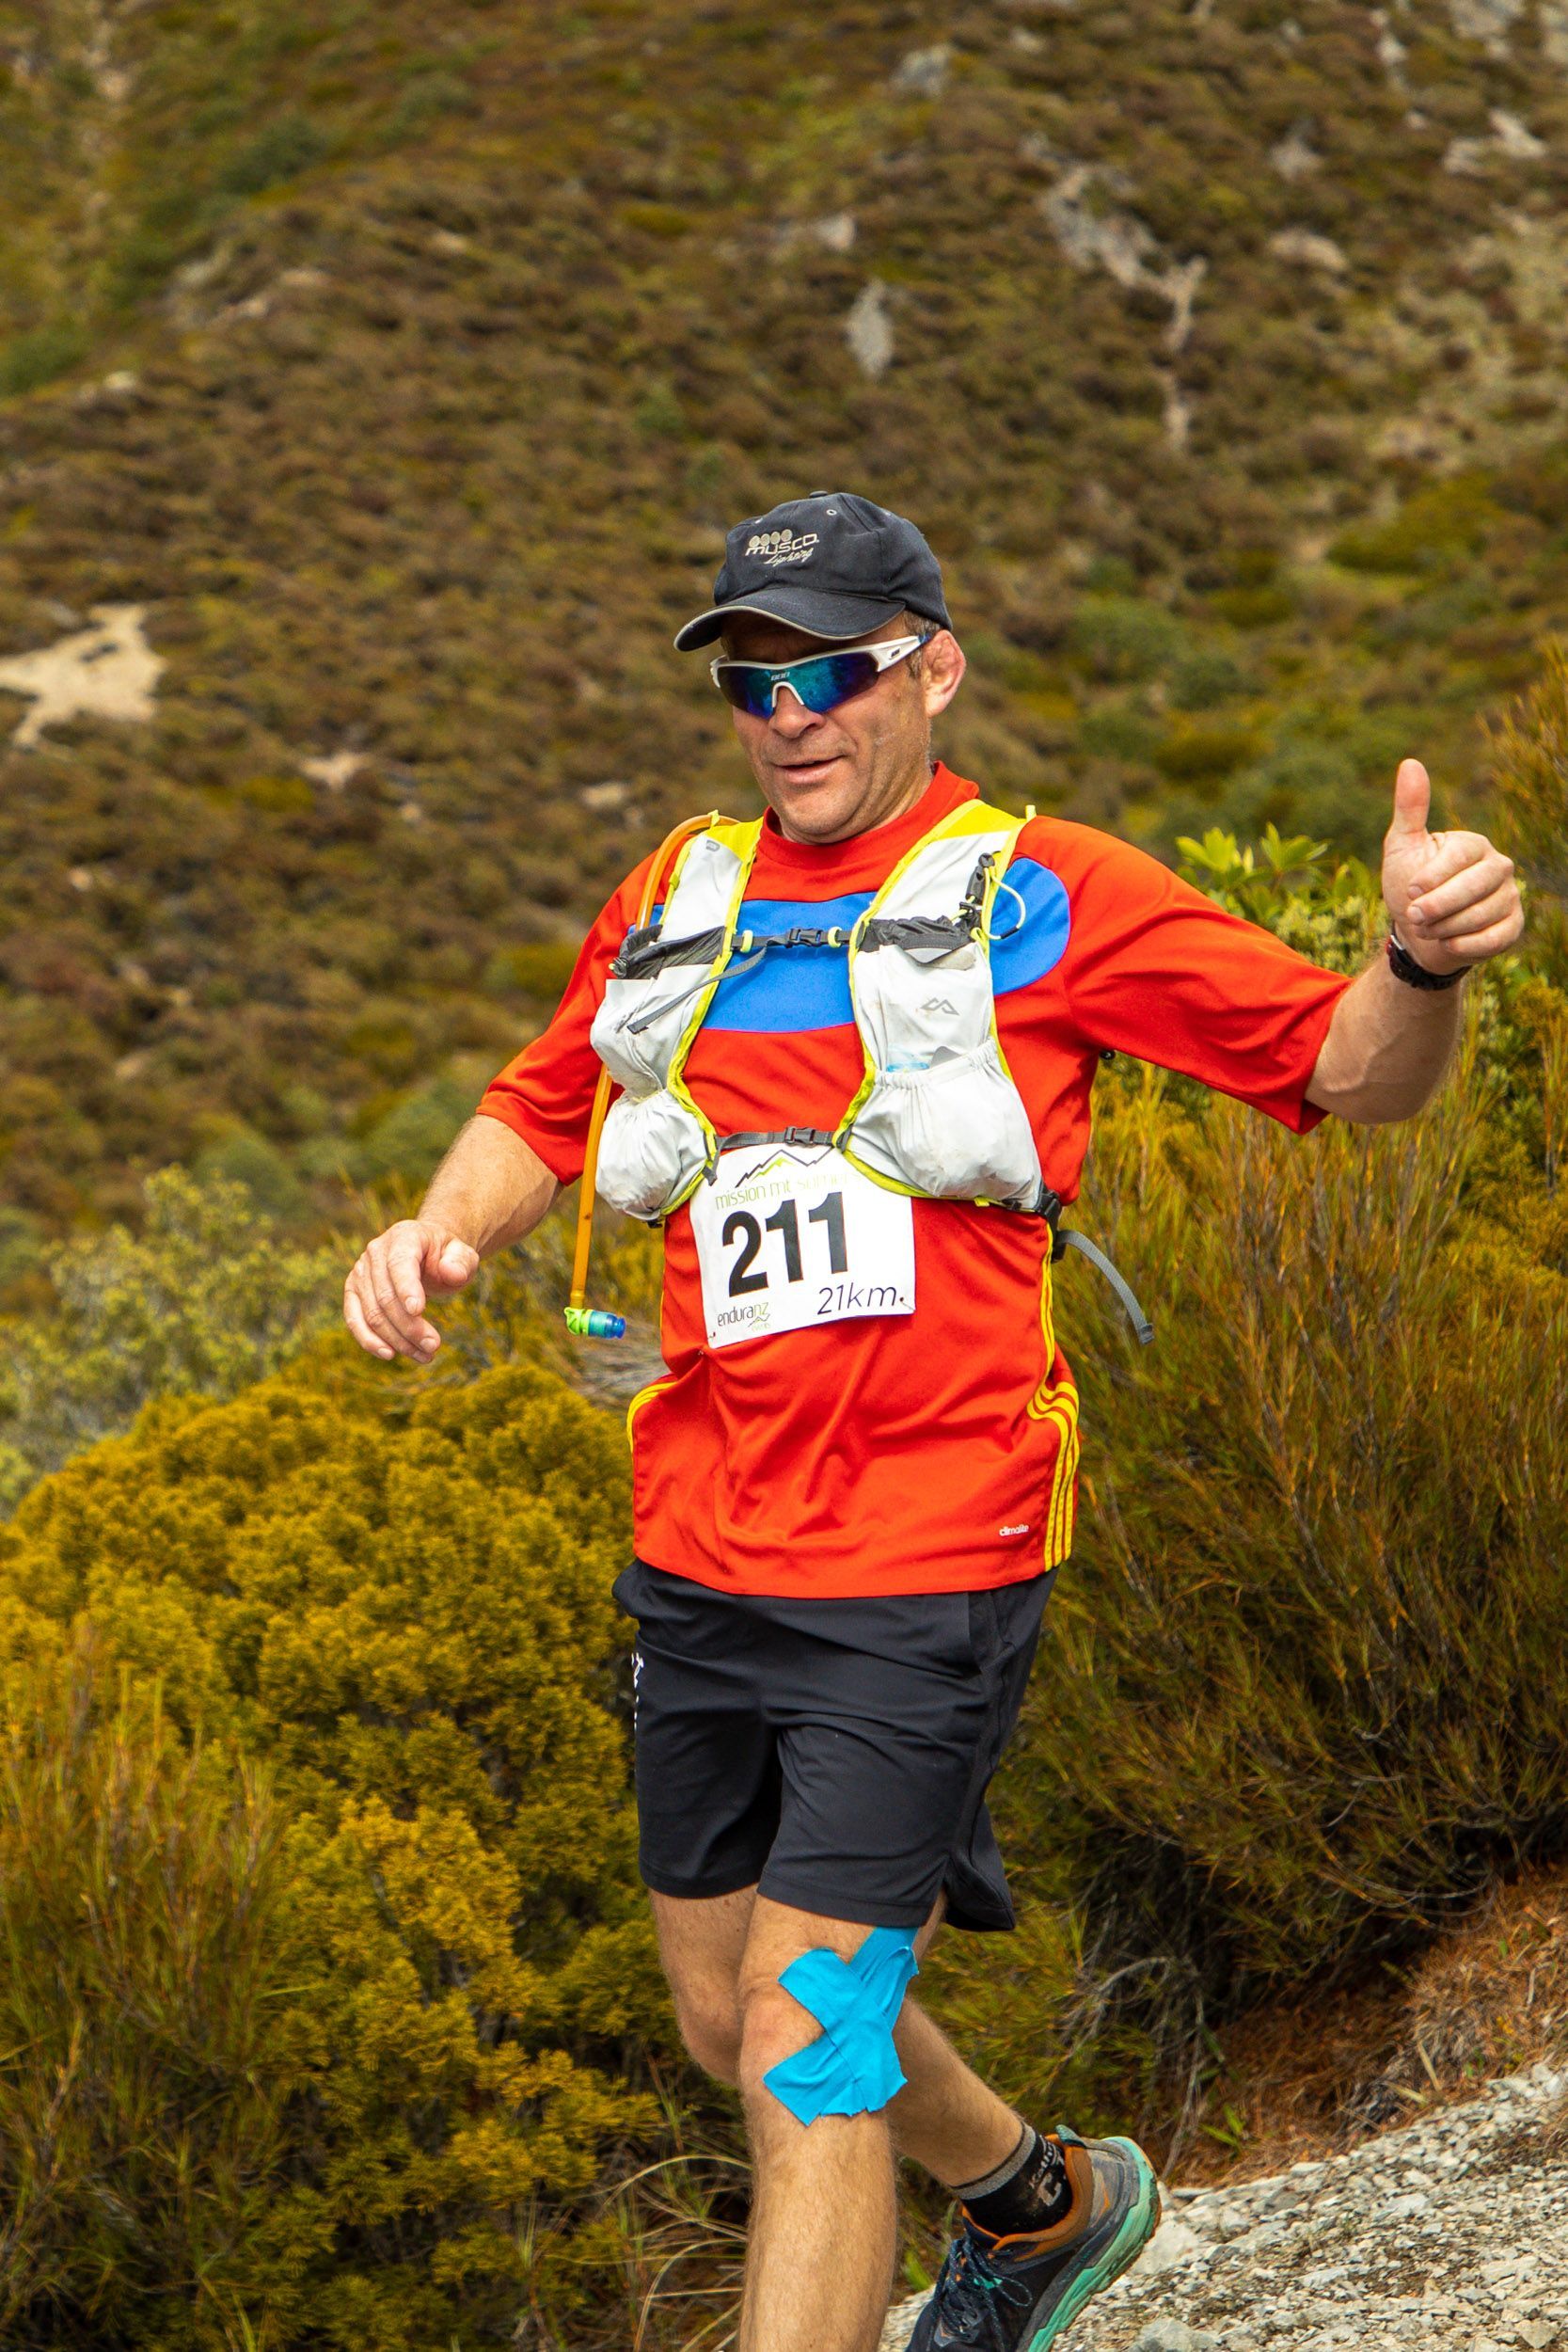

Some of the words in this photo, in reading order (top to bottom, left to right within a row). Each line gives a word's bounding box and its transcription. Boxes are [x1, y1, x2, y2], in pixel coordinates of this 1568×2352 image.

[715, 1184, 767, 1210] mission
[769, 1179, 792, 1198] mt
[722, 1191, 848, 1297] 211
[718, 1302, 768, 1327] enduranz
